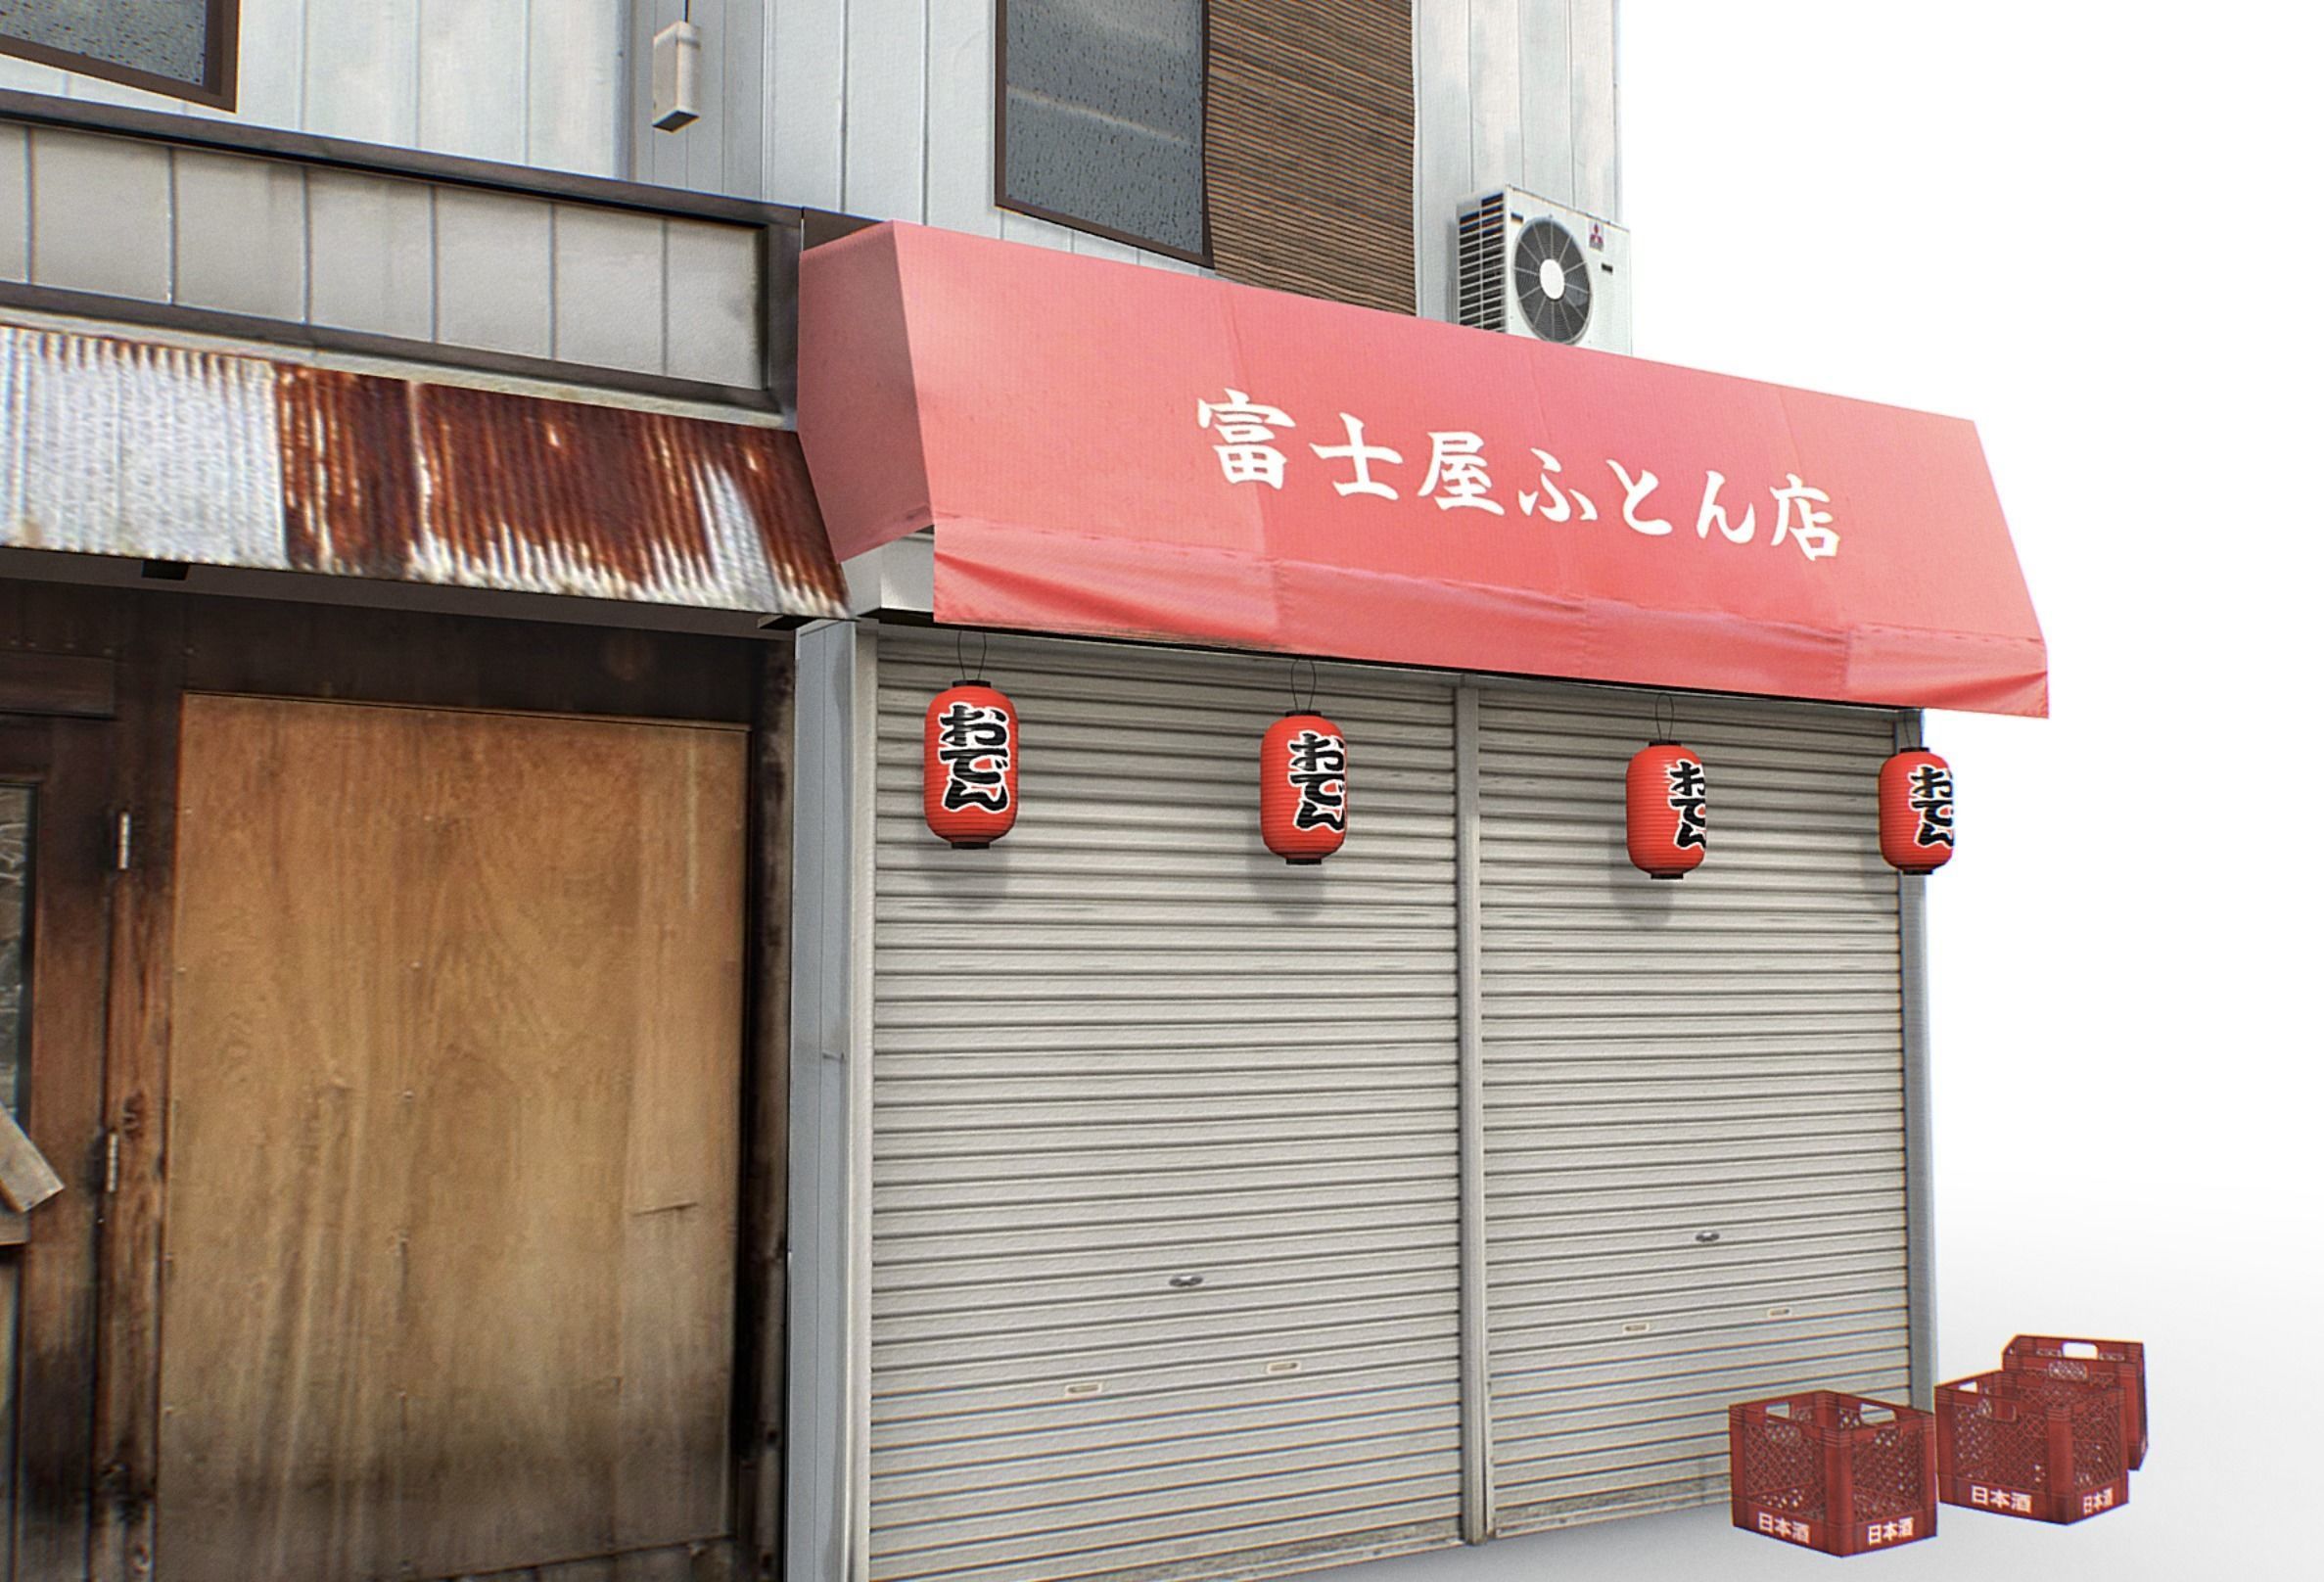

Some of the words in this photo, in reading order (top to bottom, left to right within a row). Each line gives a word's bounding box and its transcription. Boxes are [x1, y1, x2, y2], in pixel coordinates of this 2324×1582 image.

[1197, 388, 1840, 561] 富士屋ふとん店
[939, 702, 1010, 814] おでん
[1289, 731, 1346, 832] おでん
[1971, 1485, 2031, 1513] 日本酒
[2082, 1487, 2114, 1514] 日本酒
[1757, 1512, 1810, 1544] 日本酒
[1868, 1517, 1914, 1544] 日本酒
